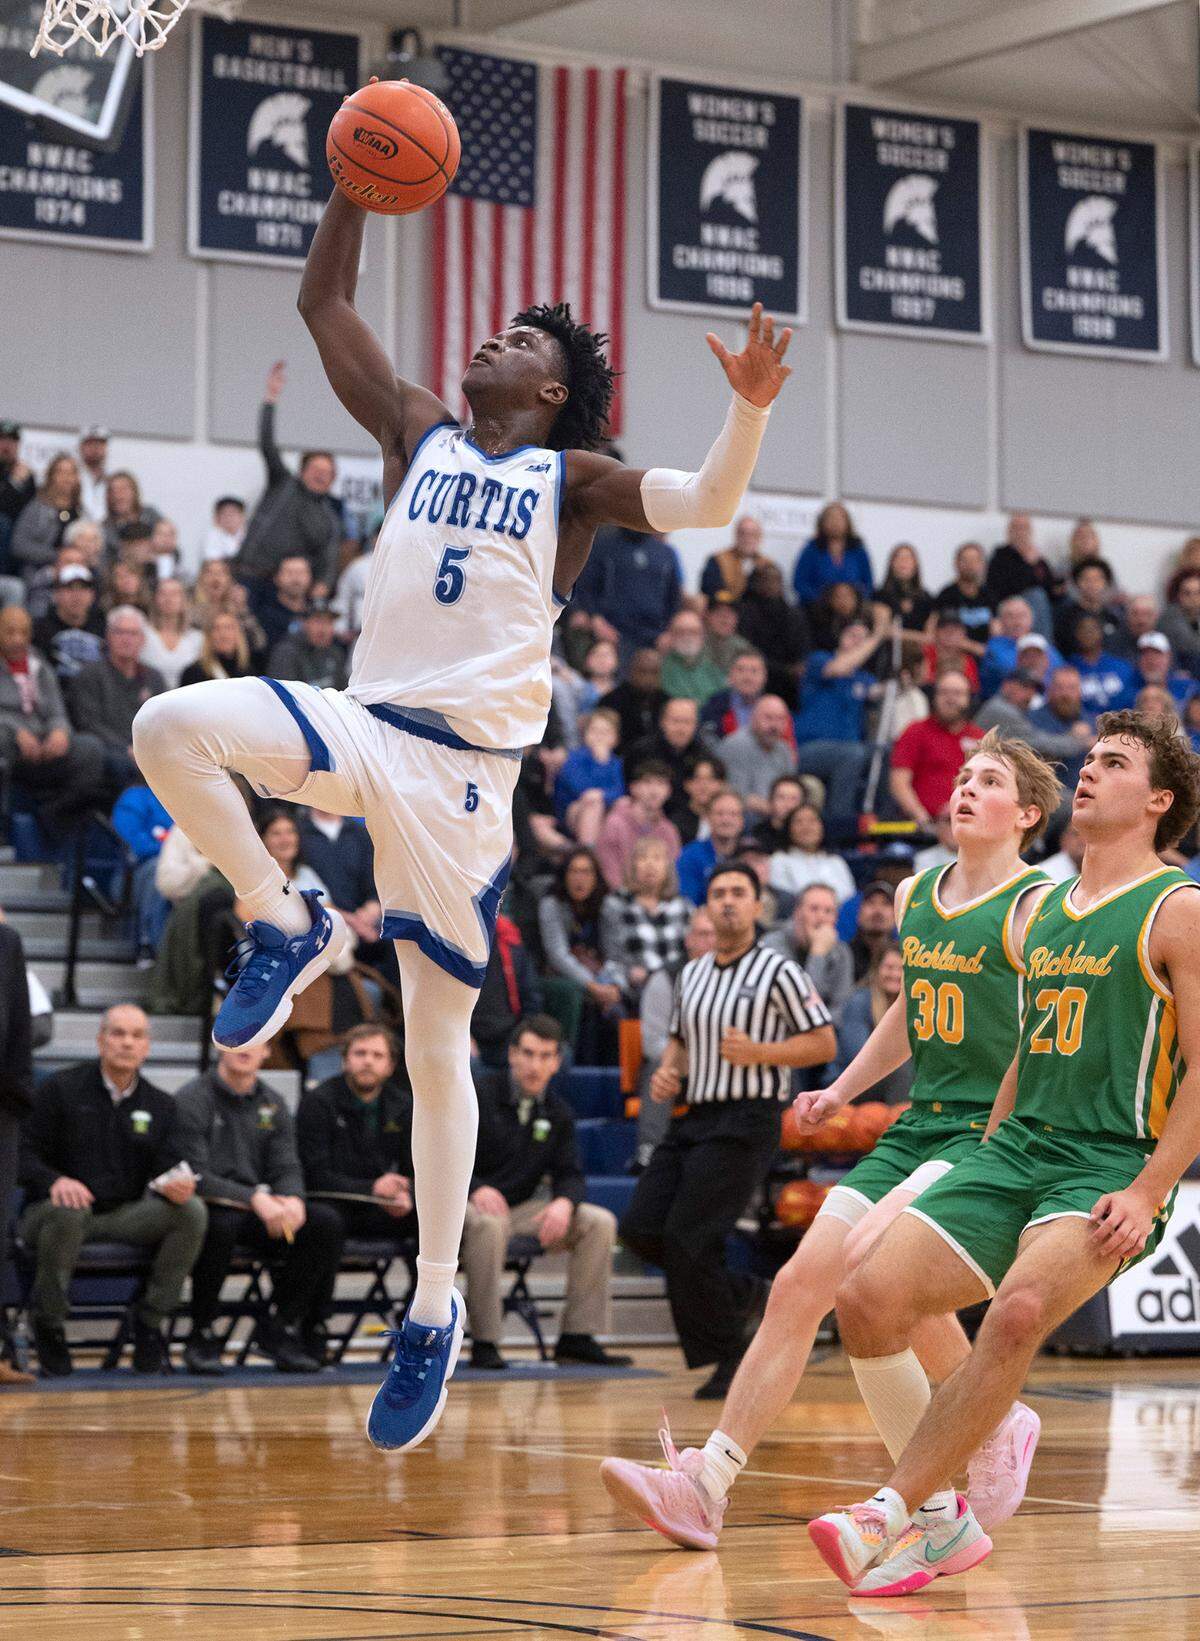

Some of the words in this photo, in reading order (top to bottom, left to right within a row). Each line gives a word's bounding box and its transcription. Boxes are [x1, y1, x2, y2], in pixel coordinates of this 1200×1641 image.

[356, 126, 391, 156] WIAA
[218, 189, 327, 224] CHAMPION
[672, 243, 783, 281] CHAMPIONS
[860, 265, 965, 302] CHAMPIONS
[1042, 286, 1144, 320] CHAMPIONS
[408, 469, 540, 540] CURTIS
[433, 543, 472, 606] 5
[463, 780, 480, 813] 5
[902, 936, 987, 974] Richland
[1026, 940, 1119, 982] Richland
[911, 978, 964, 1045] 30
[1029, 986, 1088, 1056] 20
[1137, 1277, 1198, 1323] ad
